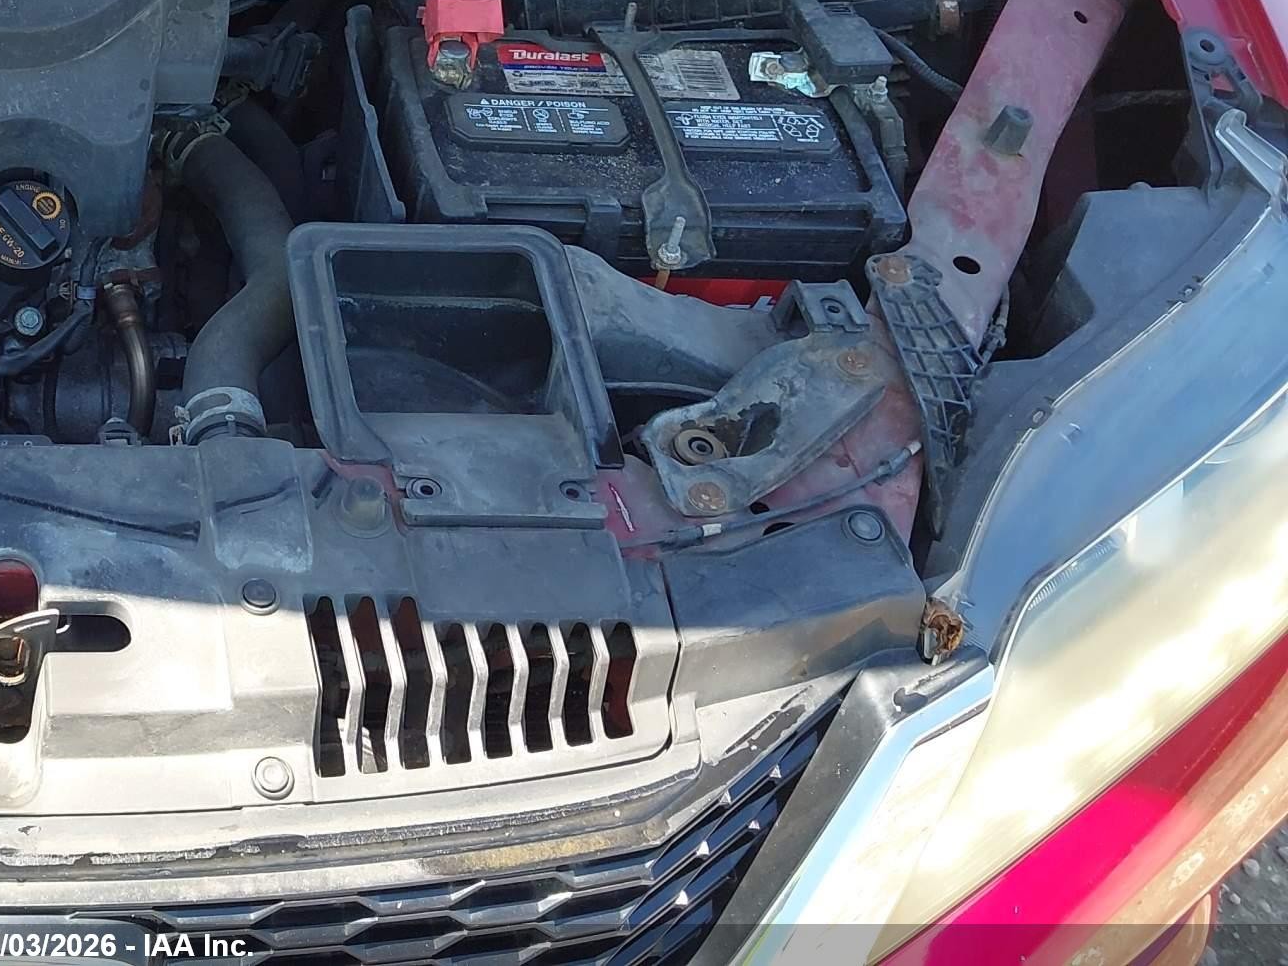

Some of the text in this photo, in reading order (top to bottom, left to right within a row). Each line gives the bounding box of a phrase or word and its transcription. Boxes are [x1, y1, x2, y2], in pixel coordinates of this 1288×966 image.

[508, 49, 589, 62] Duralast
[491, 99, 535, 107] DANGER
[546, 100, 587, 108] POISON
[15, 184, 41, 194] ENGINE
